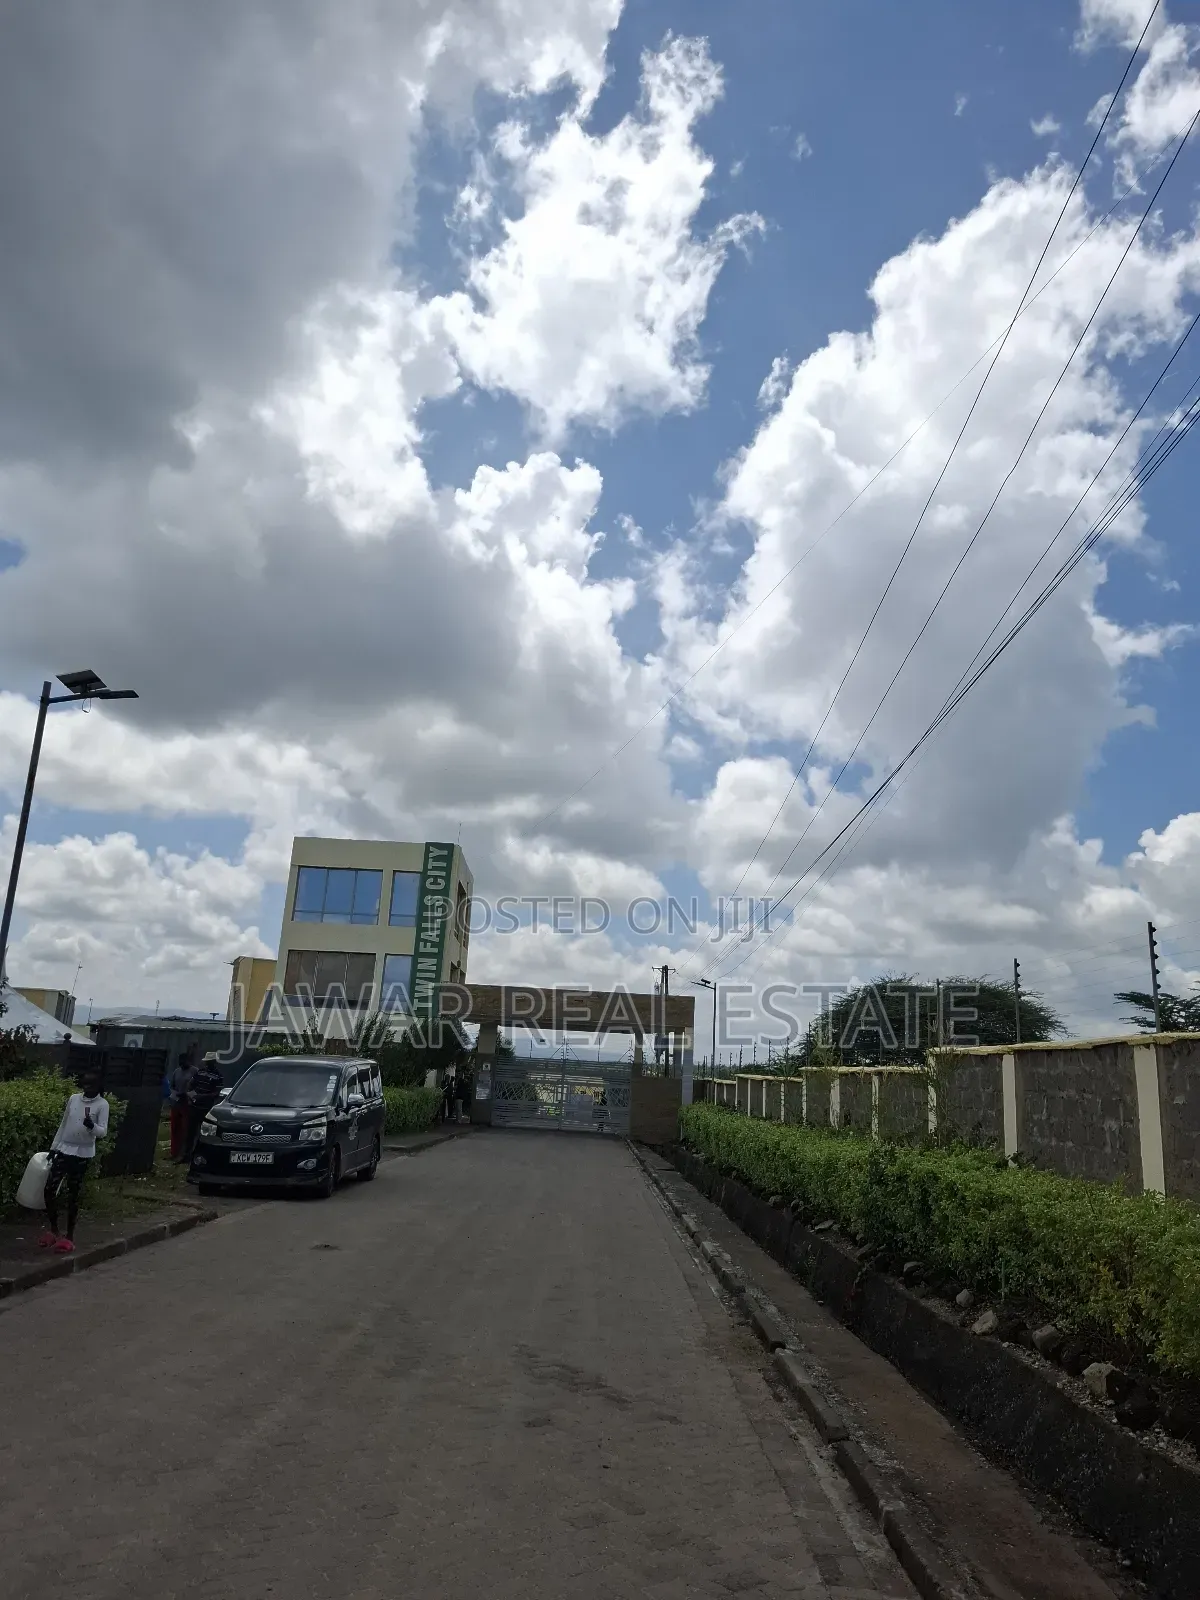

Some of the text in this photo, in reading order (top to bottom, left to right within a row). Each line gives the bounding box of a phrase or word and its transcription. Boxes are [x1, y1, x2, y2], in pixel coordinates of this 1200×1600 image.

[413, 846, 449, 1012] TWIN FALLS CITY
